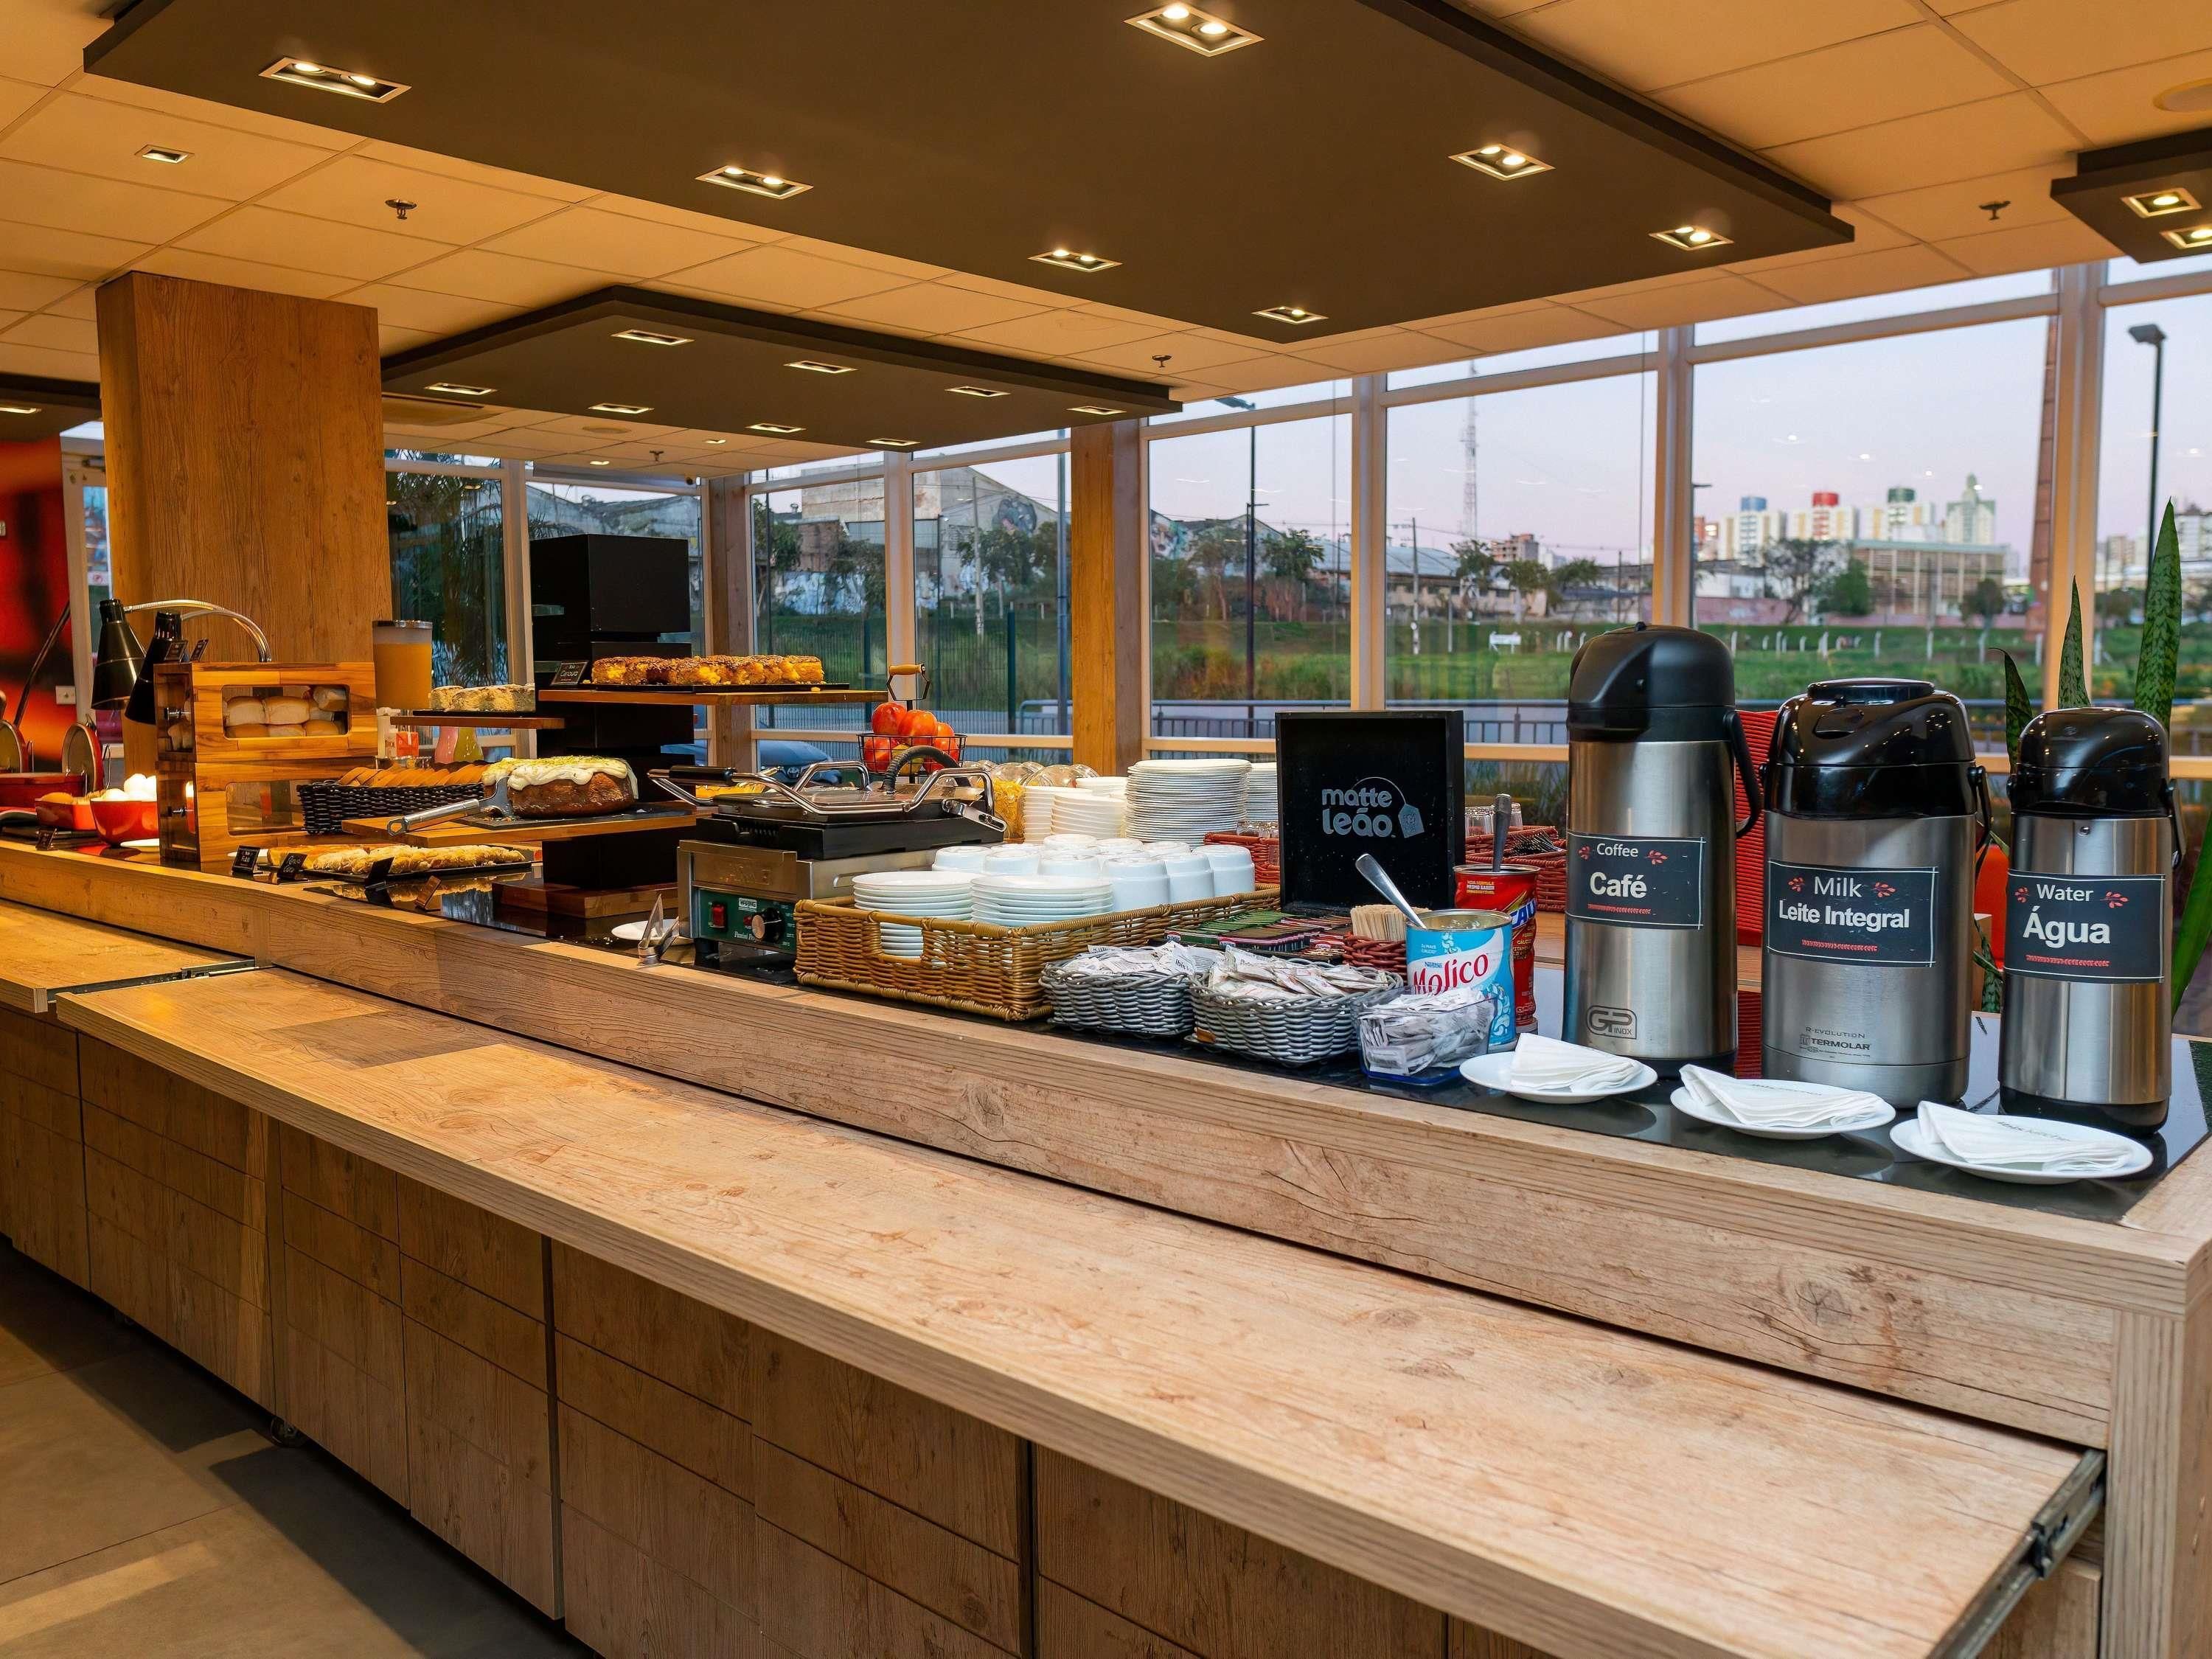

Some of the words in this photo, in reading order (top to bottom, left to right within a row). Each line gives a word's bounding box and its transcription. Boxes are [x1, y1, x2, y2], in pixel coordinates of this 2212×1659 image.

[1321, 787, 1393, 808] matte
[1322, 807, 1394, 838] leão
[1596, 843, 1639, 858] Coffee
[1590, 872, 1647, 899] Café
[1814, 876, 1863, 897] Milk
[2037, 884, 2094, 902] Water
[1779, 900, 1820, 923] Leite
[1825, 905, 1910, 933] Integral
[2023, 905, 2110, 948] Água
[1413, 954, 1489, 995] Molico
[1613, 1026, 1632, 1035] INOX
[1810, 1037, 1871, 1051] TERMOLAR
